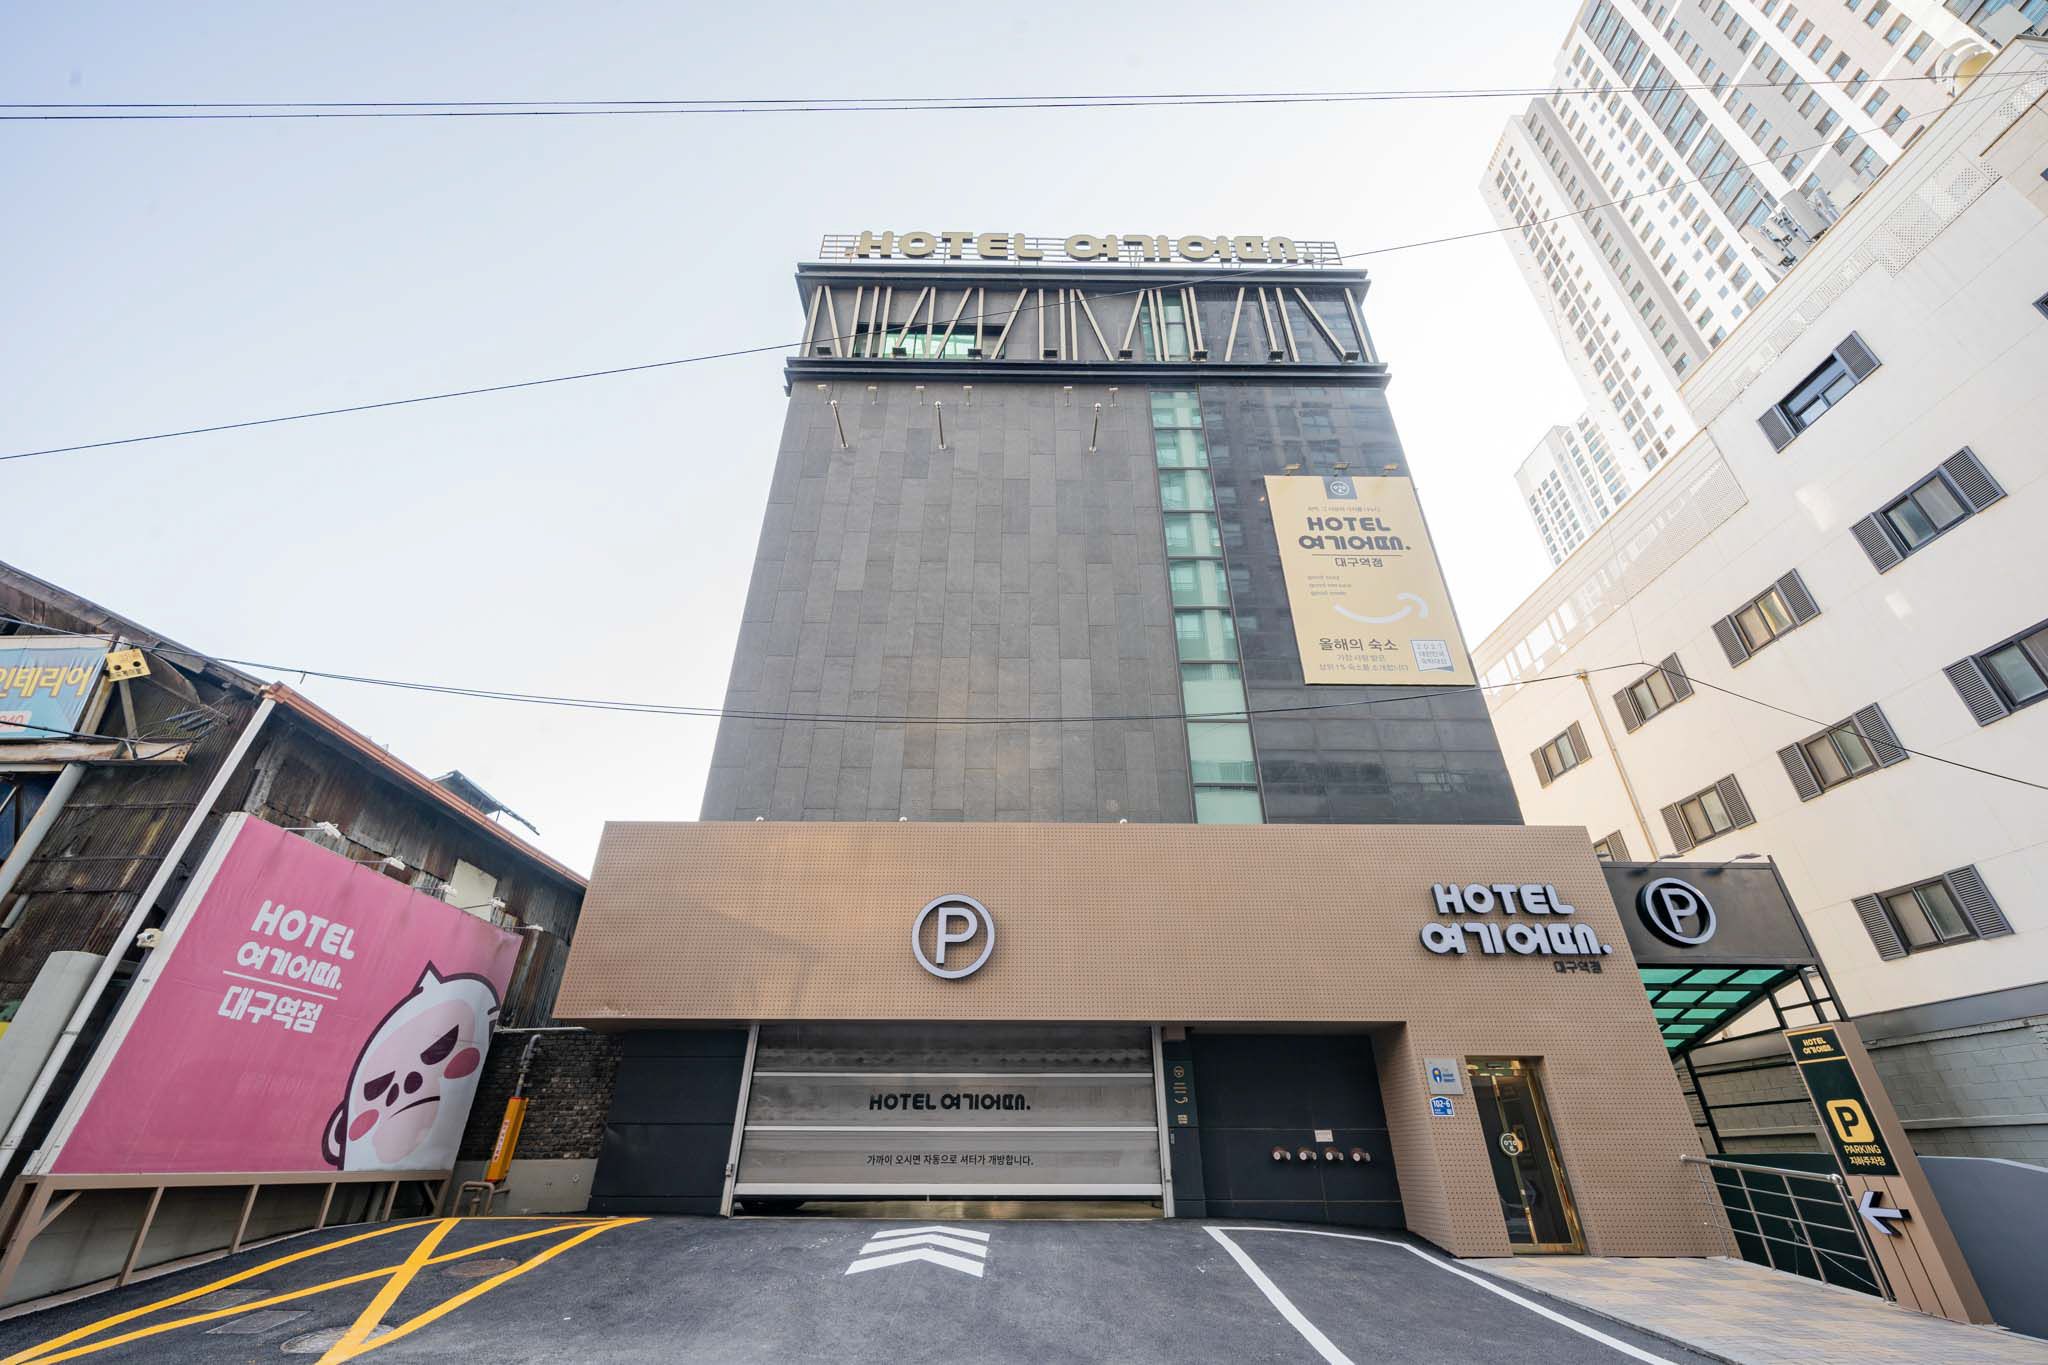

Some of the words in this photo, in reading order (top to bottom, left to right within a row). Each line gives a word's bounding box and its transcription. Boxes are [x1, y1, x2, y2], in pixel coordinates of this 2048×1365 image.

[857, 230, 1044, 261] HOTEL
[1306, 516, 1392, 531] HOTEL
[1334, 557, 1383, 568] 대구역점
[1319, 638, 1363, 651] 올해의
[1368, 638, 1399, 651] 숙소
[1431, 883, 1576, 915] HOTEL
[1660, 887, 1699, 934] P
[251, 899, 356, 960] HOTEL
[936, 907, 978, 964] P
[1553, 960, 1604, 974] 대구역점
[217, 985, 324, 1034] 대구역점
[1803, 1037, 1827, 1047] HOTEL
[869, 1093, 937, 1110] HOTEL
[1834, 1106, 1860, 1137] P
[1844, 1144, 1882, 1154] PARKING
[866, 1154, 893, 1166] 가까이
[895, 1154, 922, 1166] 오시면
[923, 1154, 958, 1166] 자동으로
[960, 1154, 986, 1166] 셔터가
[988, 1154, 1034, 1167] 개방합니다.
[1849, 1156, 1887, 1167] 지하주차장
